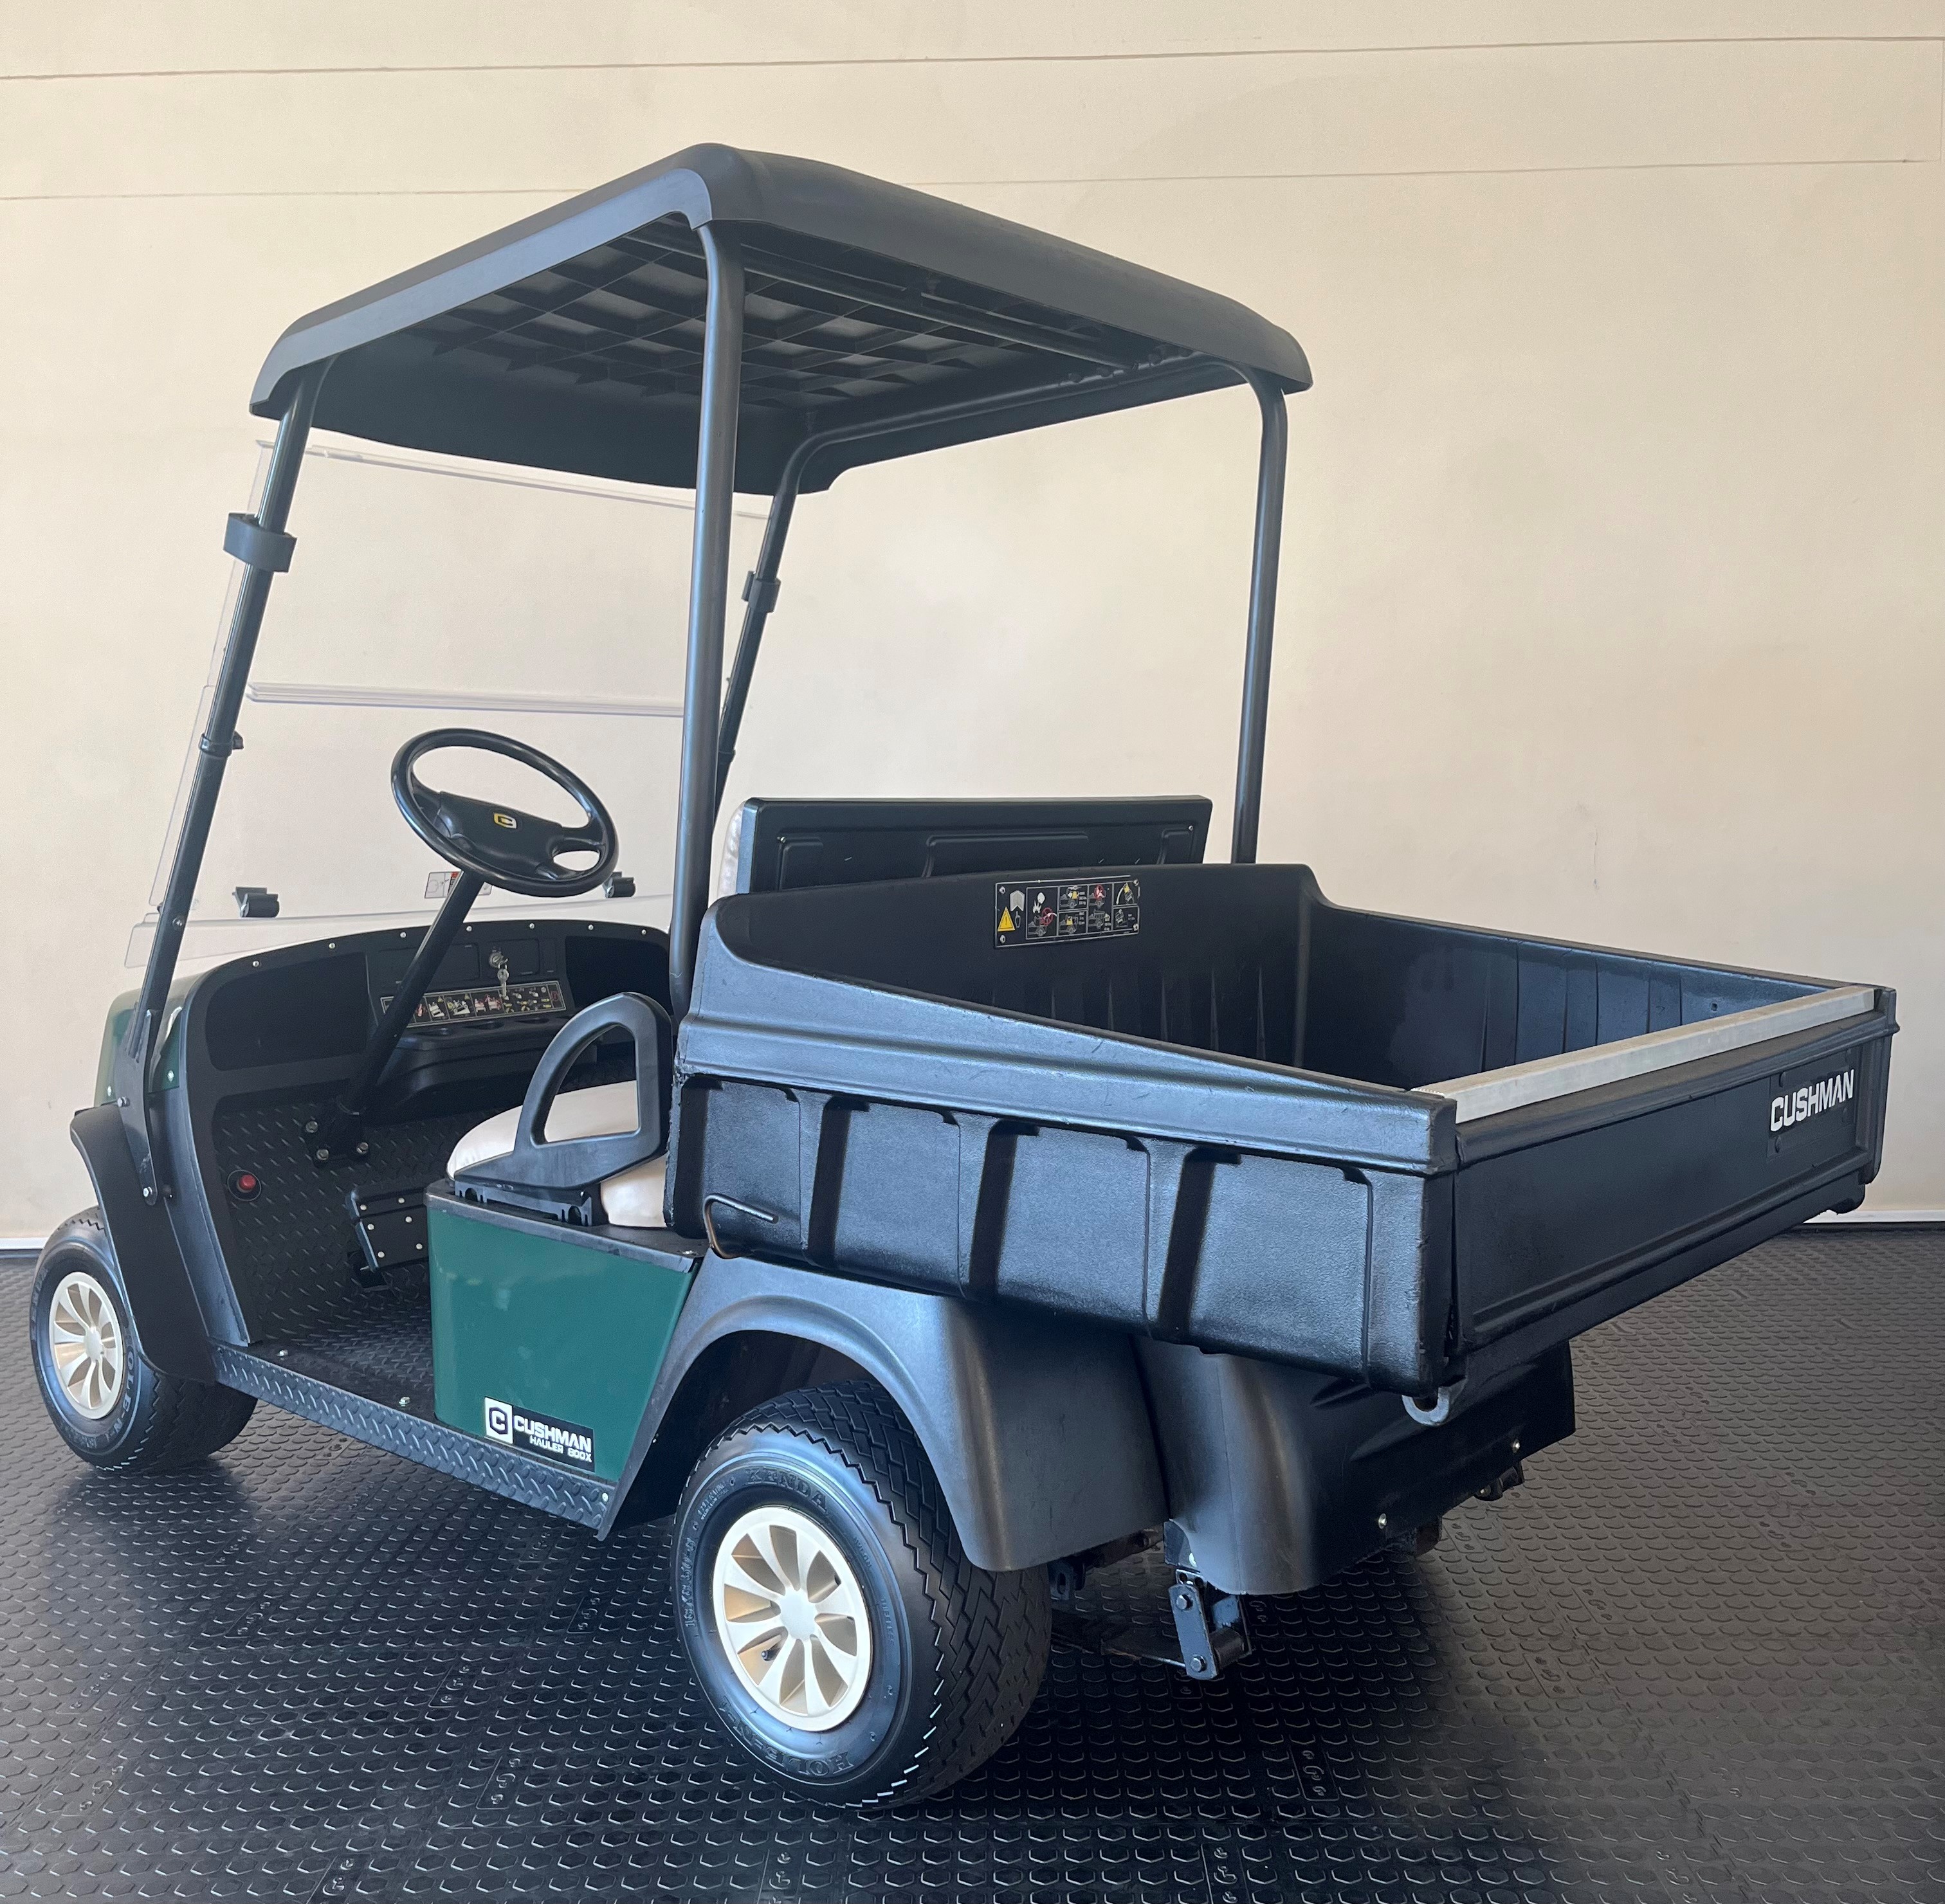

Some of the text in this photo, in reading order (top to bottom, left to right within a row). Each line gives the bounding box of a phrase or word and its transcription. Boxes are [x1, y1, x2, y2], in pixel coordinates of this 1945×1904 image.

[1770, 1069, 1854, 1132] CUSHMAN
[513, 1415, 592, 1453] CUSHMAN
[529, 1435, 592, 1463] HAULER 800X
[744, 1465, 829, 1516] KENDA
